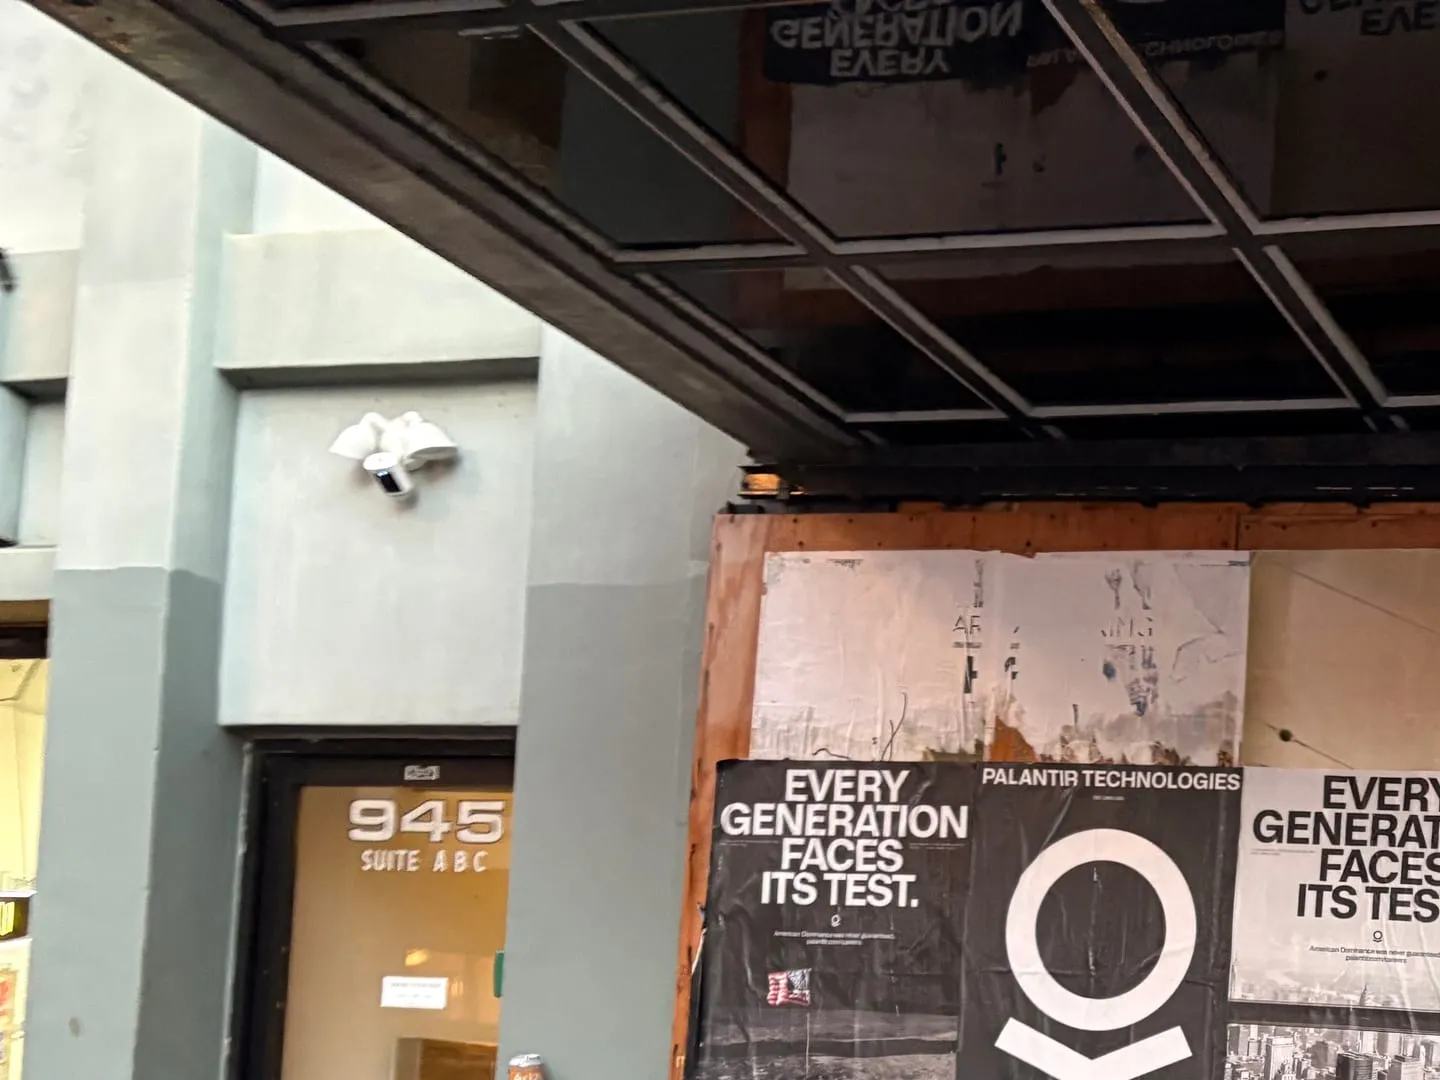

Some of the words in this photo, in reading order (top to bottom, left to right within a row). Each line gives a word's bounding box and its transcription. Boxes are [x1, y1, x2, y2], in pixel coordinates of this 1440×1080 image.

[785, 769, 909, 802] EVERY
[983, 768, 1078, 786] PALANTIR
[1082, 770, 1240, 790] TECHNOLOGIES
[348, 800, 506, 843] 945
[721, 803, 968, 838] GENERATION
[361, 850, 420, 872] SUITE
[781, 838, 903, 872] FACES
[762, 872, 817, 905] ITS
[824, 873, 918, 907] TEST.
[1298, 884, 1357, 919] ITS
